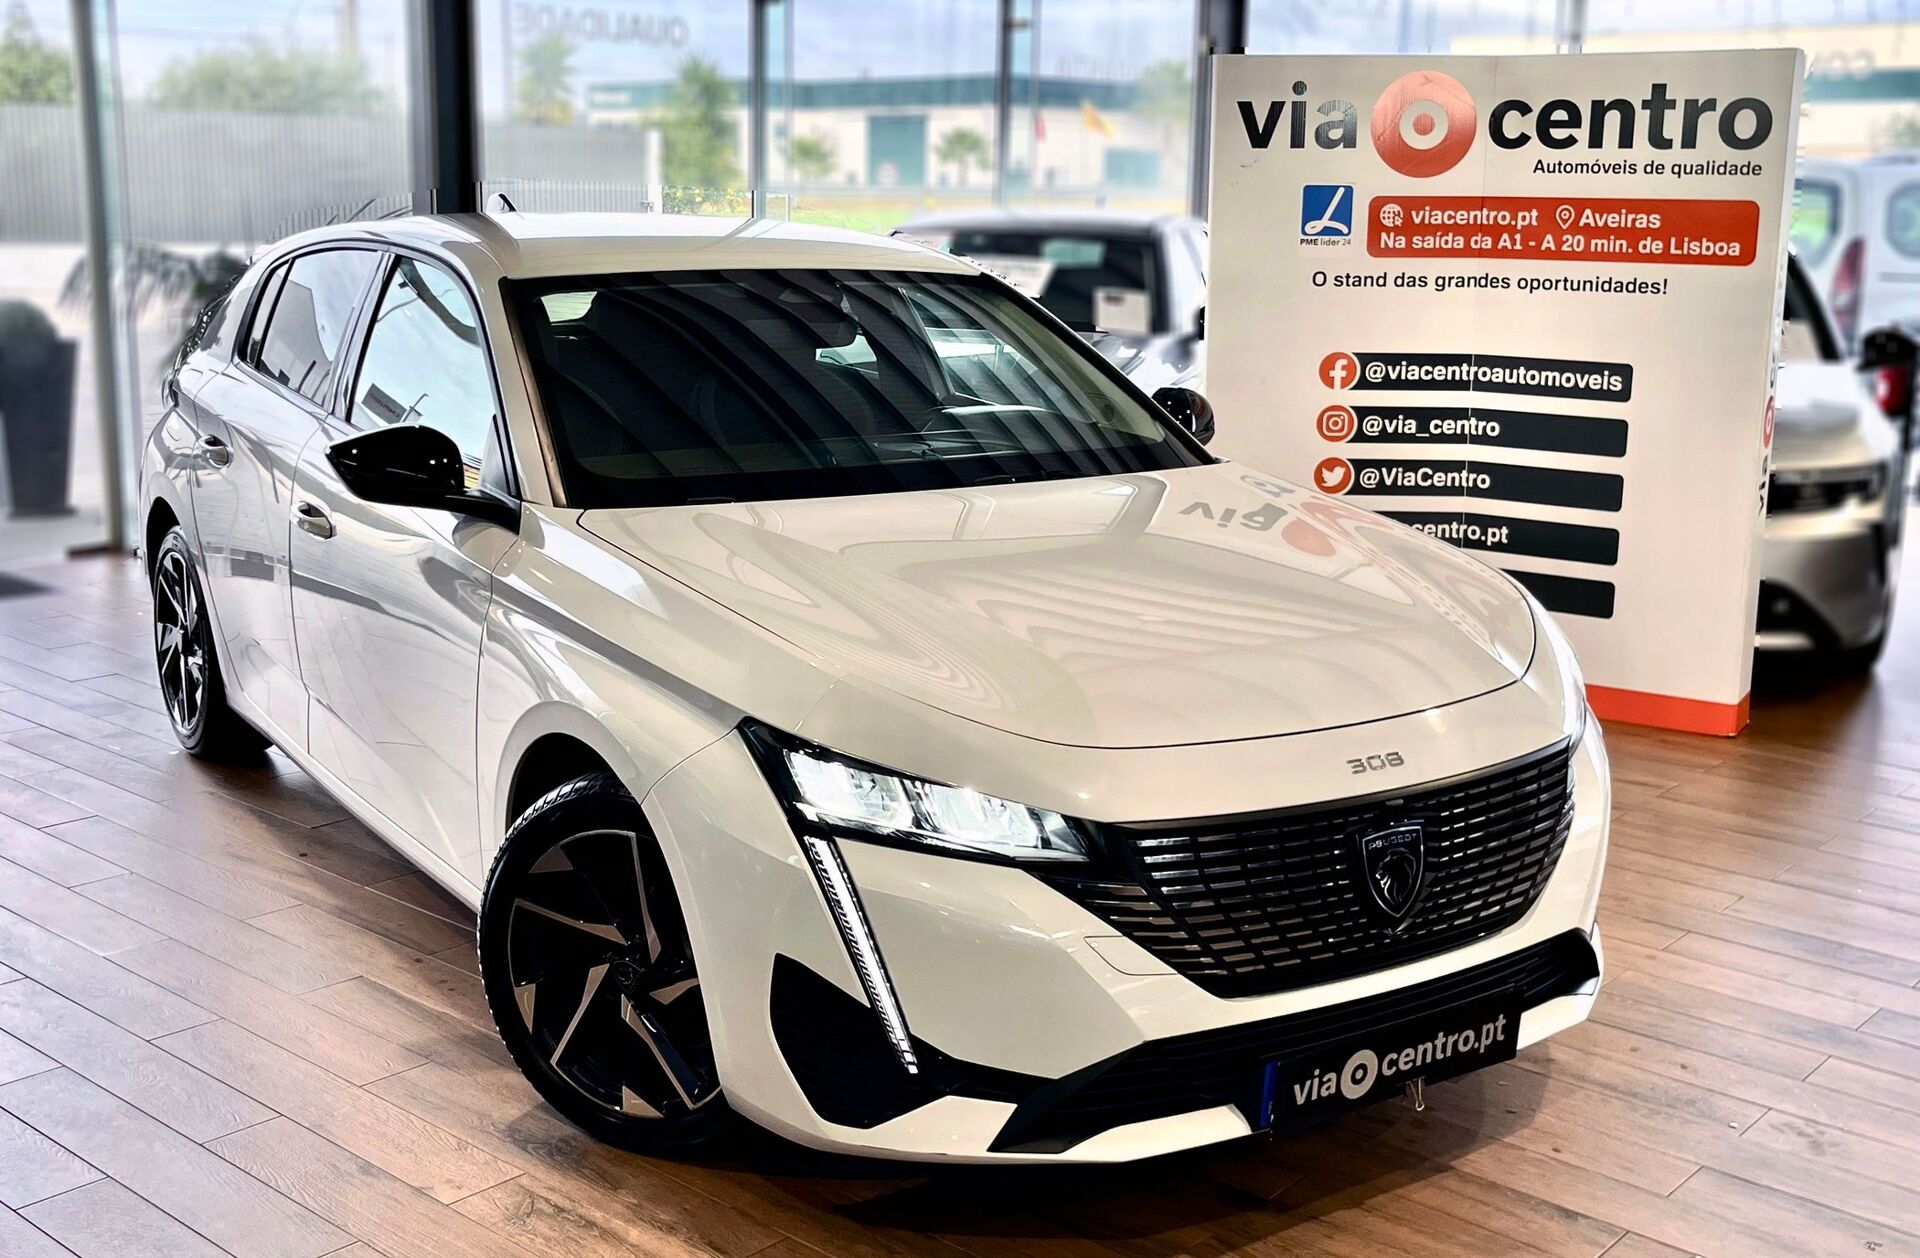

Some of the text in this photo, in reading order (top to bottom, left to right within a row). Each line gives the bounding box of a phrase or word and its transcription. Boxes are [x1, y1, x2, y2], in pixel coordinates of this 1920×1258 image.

[1237, 80, 1773, 150] via centro
[1533, 158, 1763, 178] Automóveis de qualidade
[1411, 206, 1662, 230] viacentro.pt Aveiras
[1300, 238, 1319, 246] PME
[1380, 232, 1406, 249] Na
[1411, 232, 1464, 249] saída
[1470, 233, 1492, 249] da
[1497, 233, 1523, 250] A1
[1541, 234, 1556, 251] A
[1561, 234, 1585, 252] 20
[1590, 235, 1633, 253] min.
[1638, 237, 1664, 254] de
[1669, 237, 1741, 257] Lisboa
[1312, 271, 1669, 295] O stand das grandes oportunidades!
[1365, 361, 1623, 391] @viacentroautomoveis
[1362, 415, 1500, 437] @via_centro
[1359, 467, 1491, 489] @ViaCentro
[1346, 752, 1405, 775] 308
[1368, 833, 1417, 851] PEUGEOT
[1293, 1014, 1507, 1105] via centro.pt
